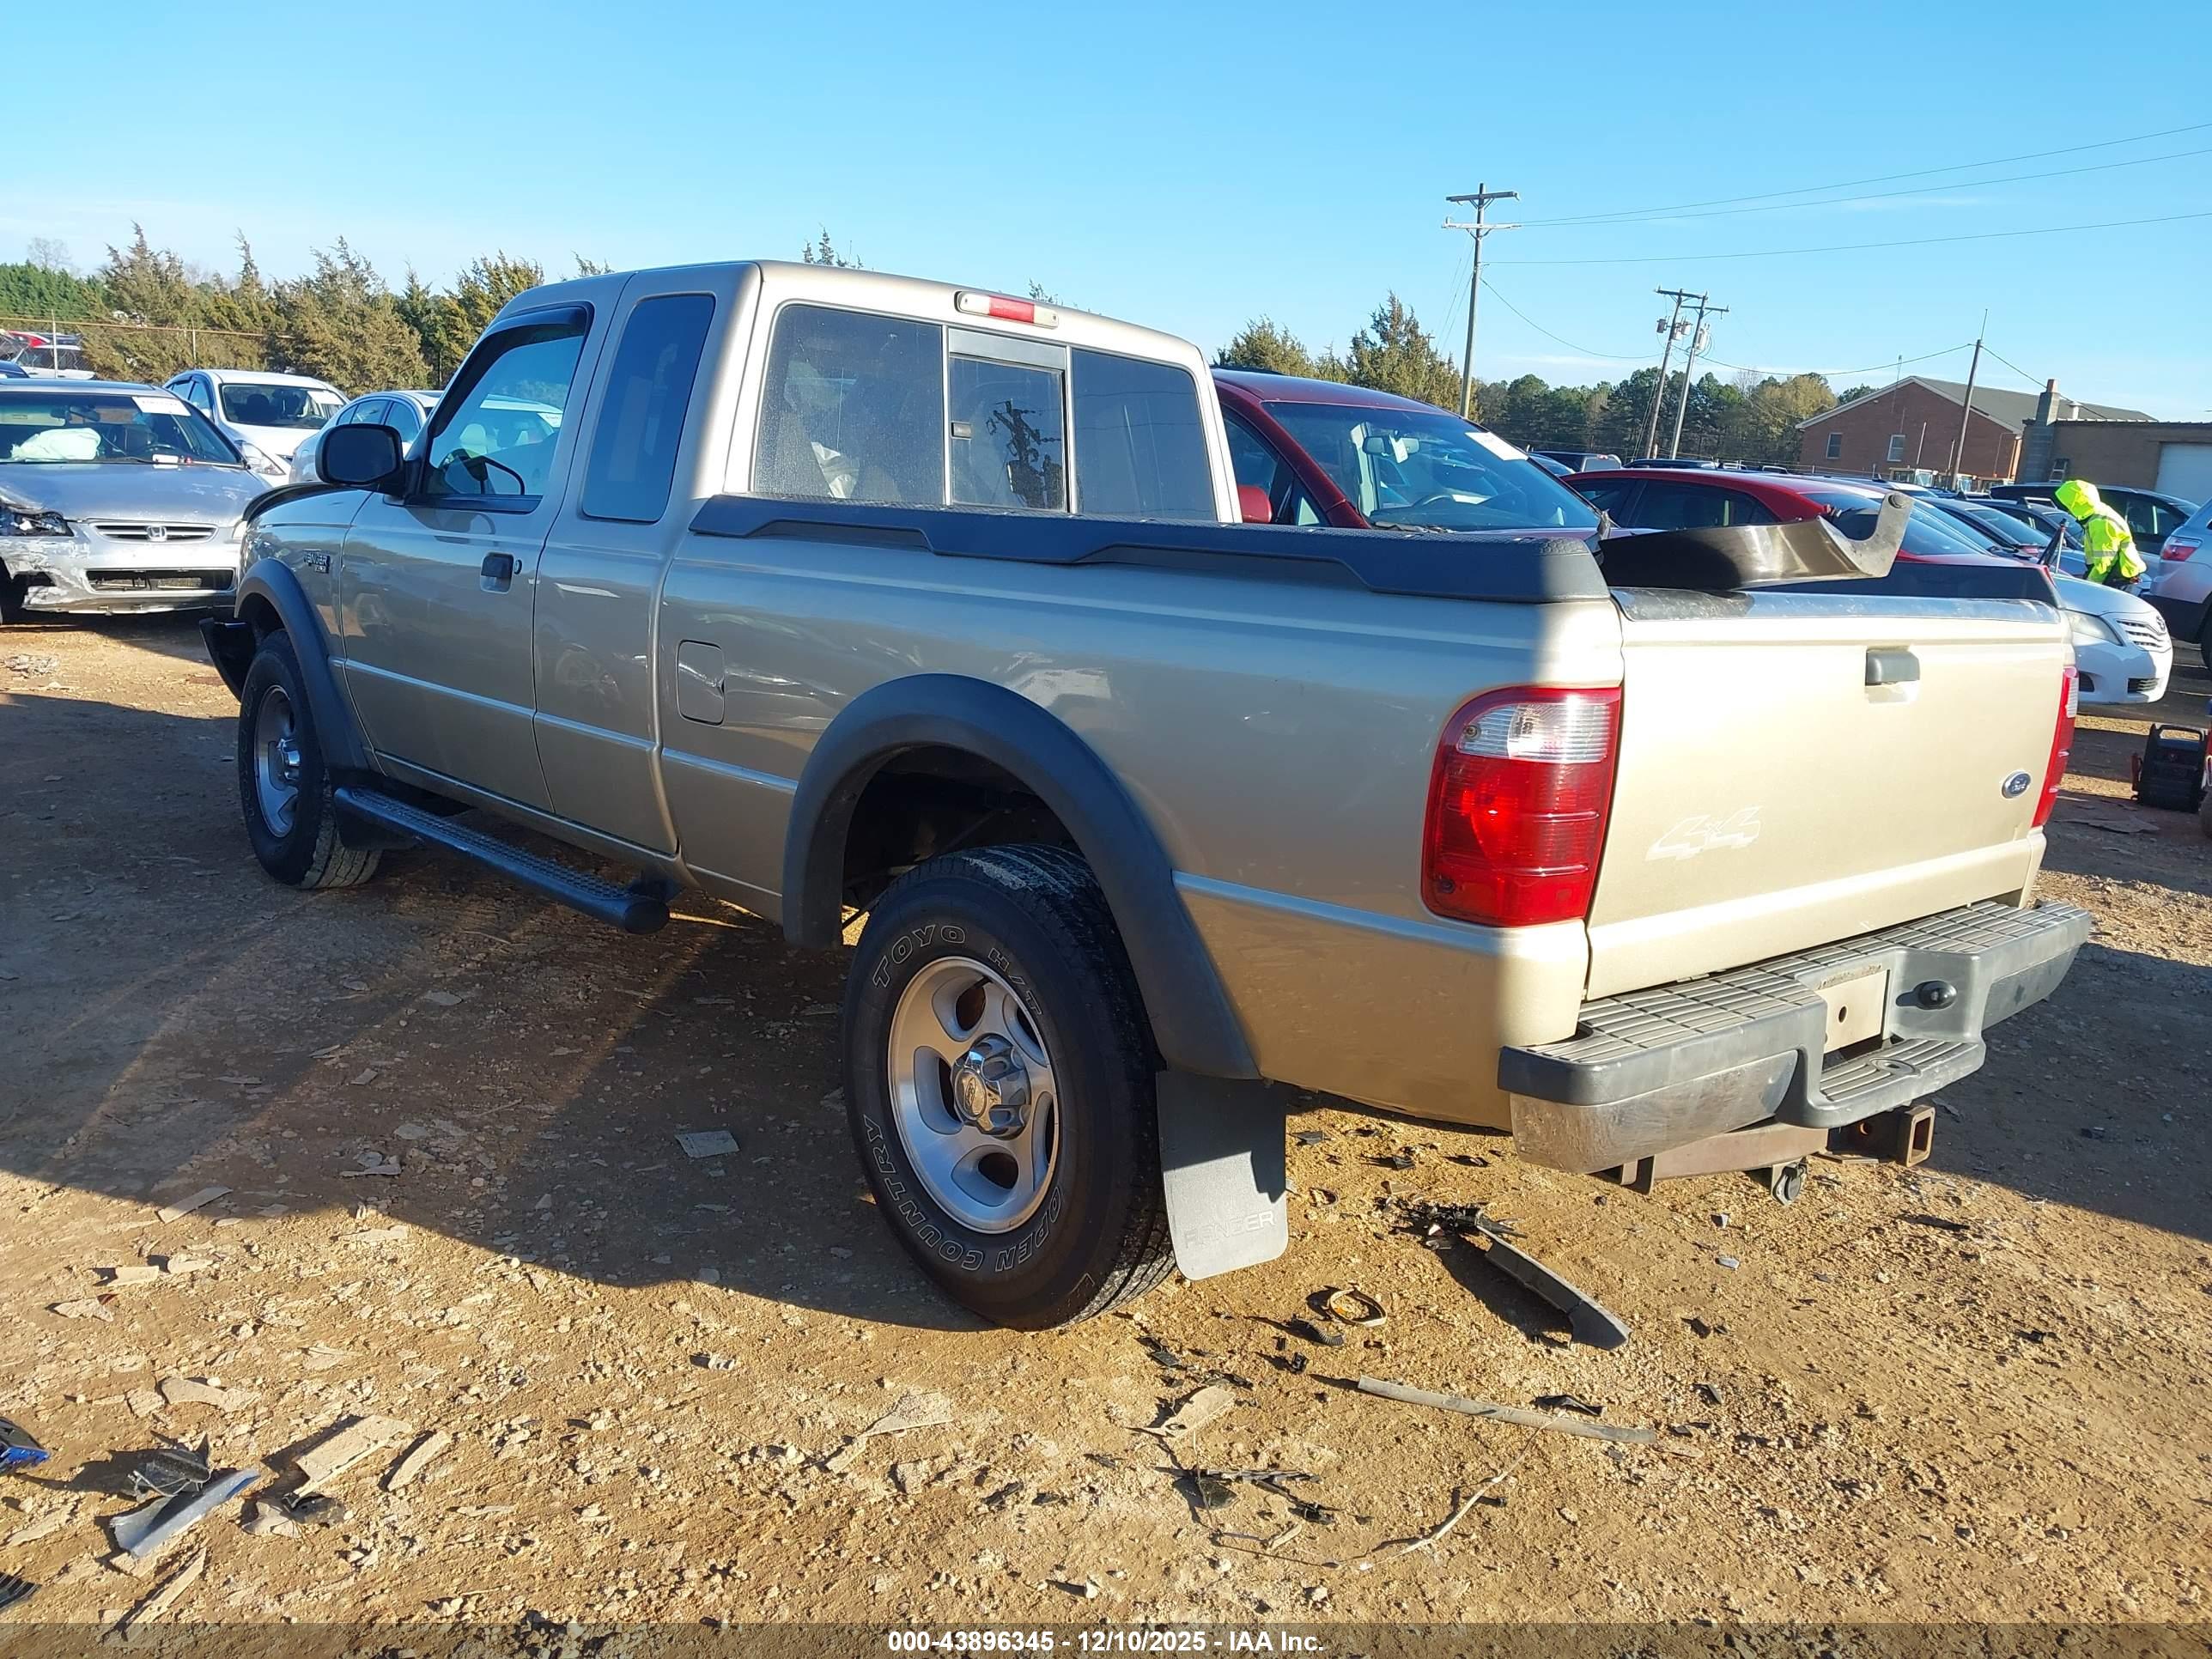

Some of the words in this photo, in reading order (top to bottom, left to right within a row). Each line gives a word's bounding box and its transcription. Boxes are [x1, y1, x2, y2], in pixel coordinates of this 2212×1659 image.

[872, 924, 966, 988] TOYO
[988, 947, 1042, 1015] H/T
[863, 1114, 984, 1271] COUNTRY
[994, 1186, 1062, 1272] OPEN
[1184, 1209, 1277, 1249] RANGER
